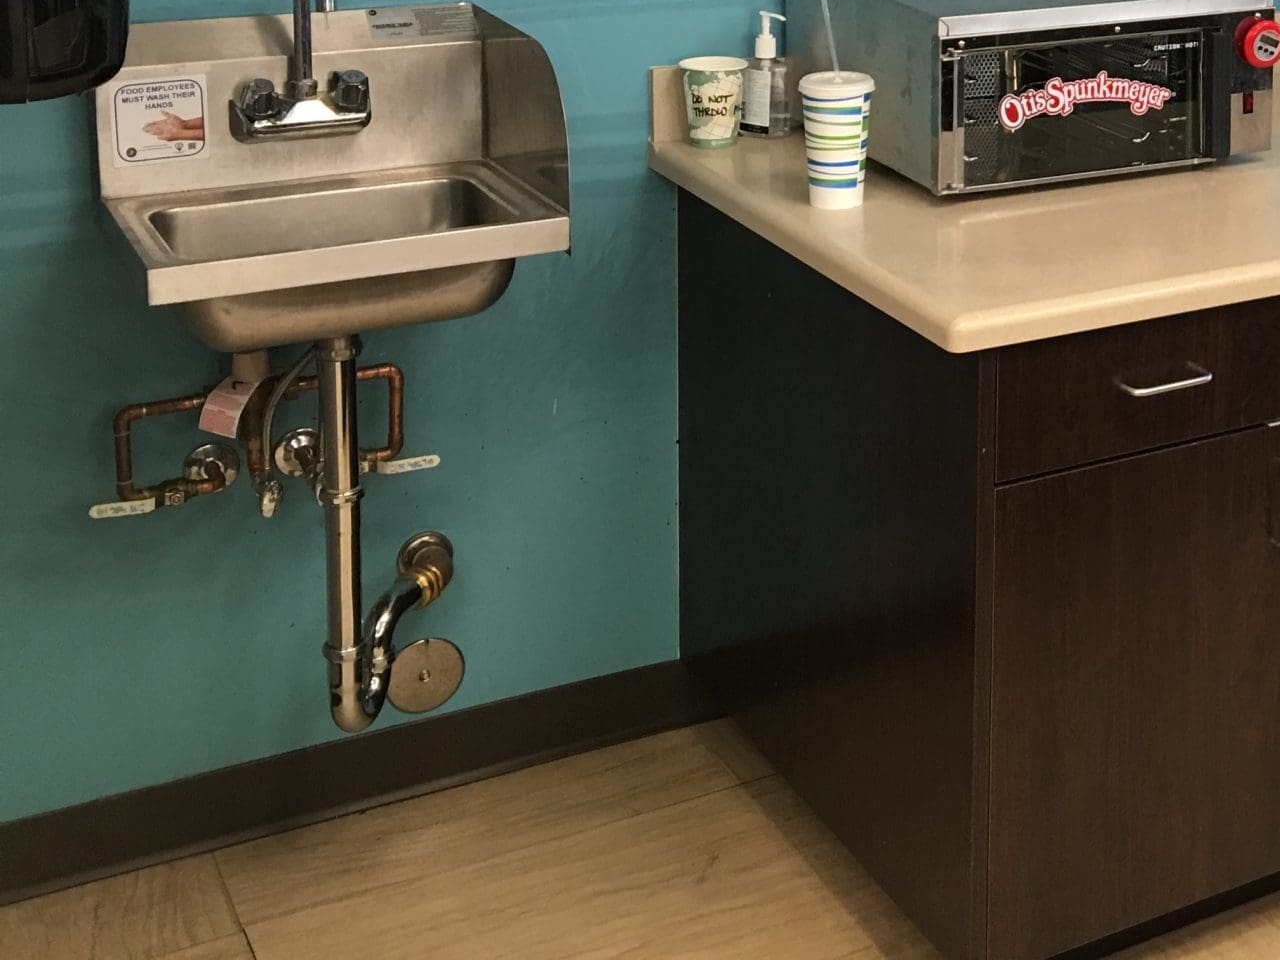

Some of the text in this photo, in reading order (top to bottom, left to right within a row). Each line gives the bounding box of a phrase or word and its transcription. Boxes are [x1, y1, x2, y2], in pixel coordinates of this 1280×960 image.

[120, 82, 195, 95] FOOD EMPLOYEES
[121, 91, 196, 104] MUST WASH THEIR
[691, 93, 734, 104] DO NOT
[1000, 71, 1170, 129] Otis Spunkmeyer
[144, 101, 174, 110] HANDS
